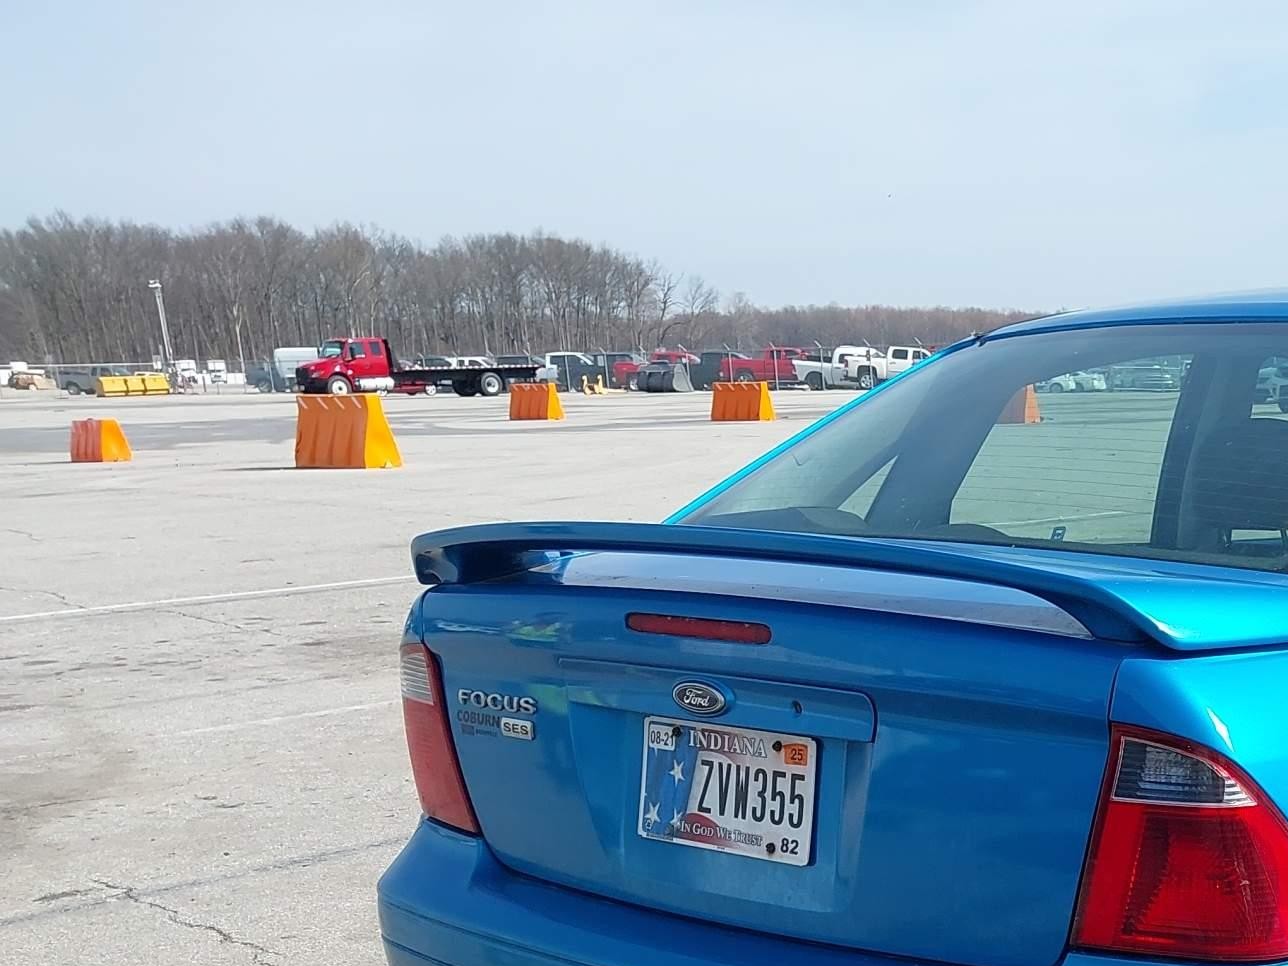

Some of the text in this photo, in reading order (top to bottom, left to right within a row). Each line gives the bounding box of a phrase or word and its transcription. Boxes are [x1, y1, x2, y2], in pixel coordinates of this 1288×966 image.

[457, 688, 537, 714] FOCUS
[683, 688, 710, 707] Ford
[457, 710, 500, 728] COBURN
[503, 721, 529, 735] SES
[688, 729, 768, 758] INDIANA
[791, 748, 803, 761] 25
[697, 759, 806, 829] ZVW355
[780, 837, 799, 855] 82
